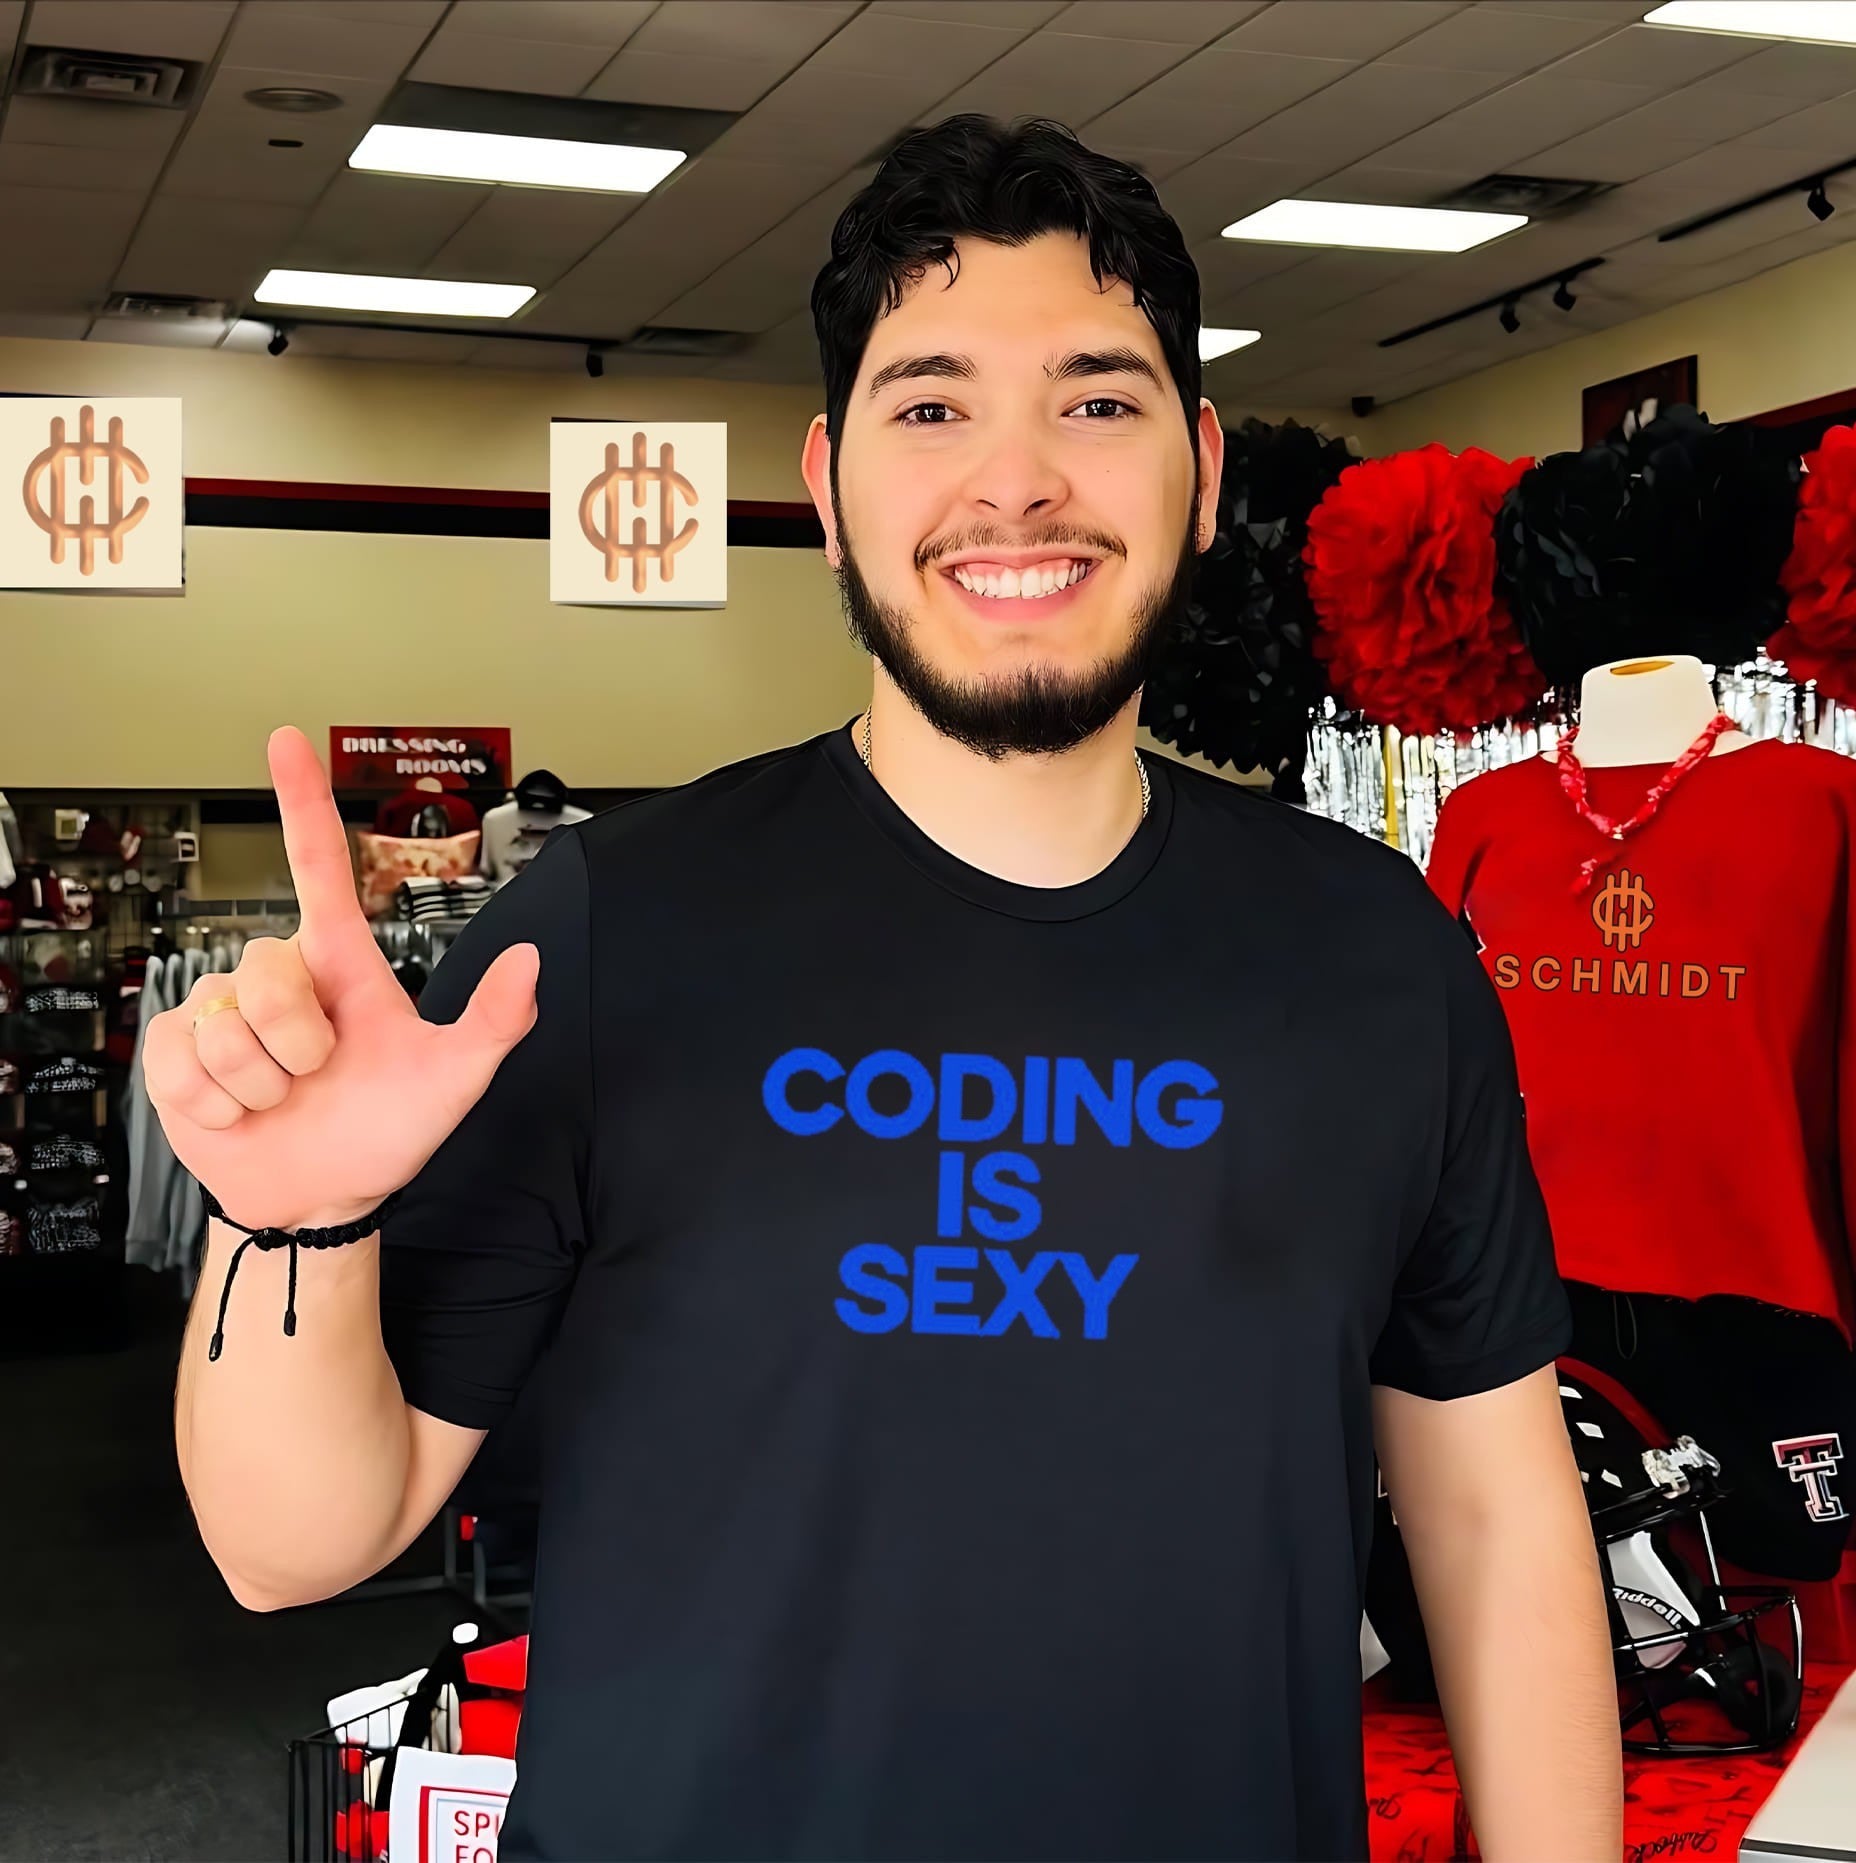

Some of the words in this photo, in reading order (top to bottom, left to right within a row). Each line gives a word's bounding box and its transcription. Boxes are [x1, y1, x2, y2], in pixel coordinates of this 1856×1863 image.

[342, 737, 467, 753] DRESSING
[396, 758, 487, 775] ROOMS
[1493, 953, 1747, 1001] SCHMIDT
[762, 1047, 1224, 1150] CODING
[937, 1150, 1042, 1242] IS
[834, 1242, 1140, 1341] SEXY
